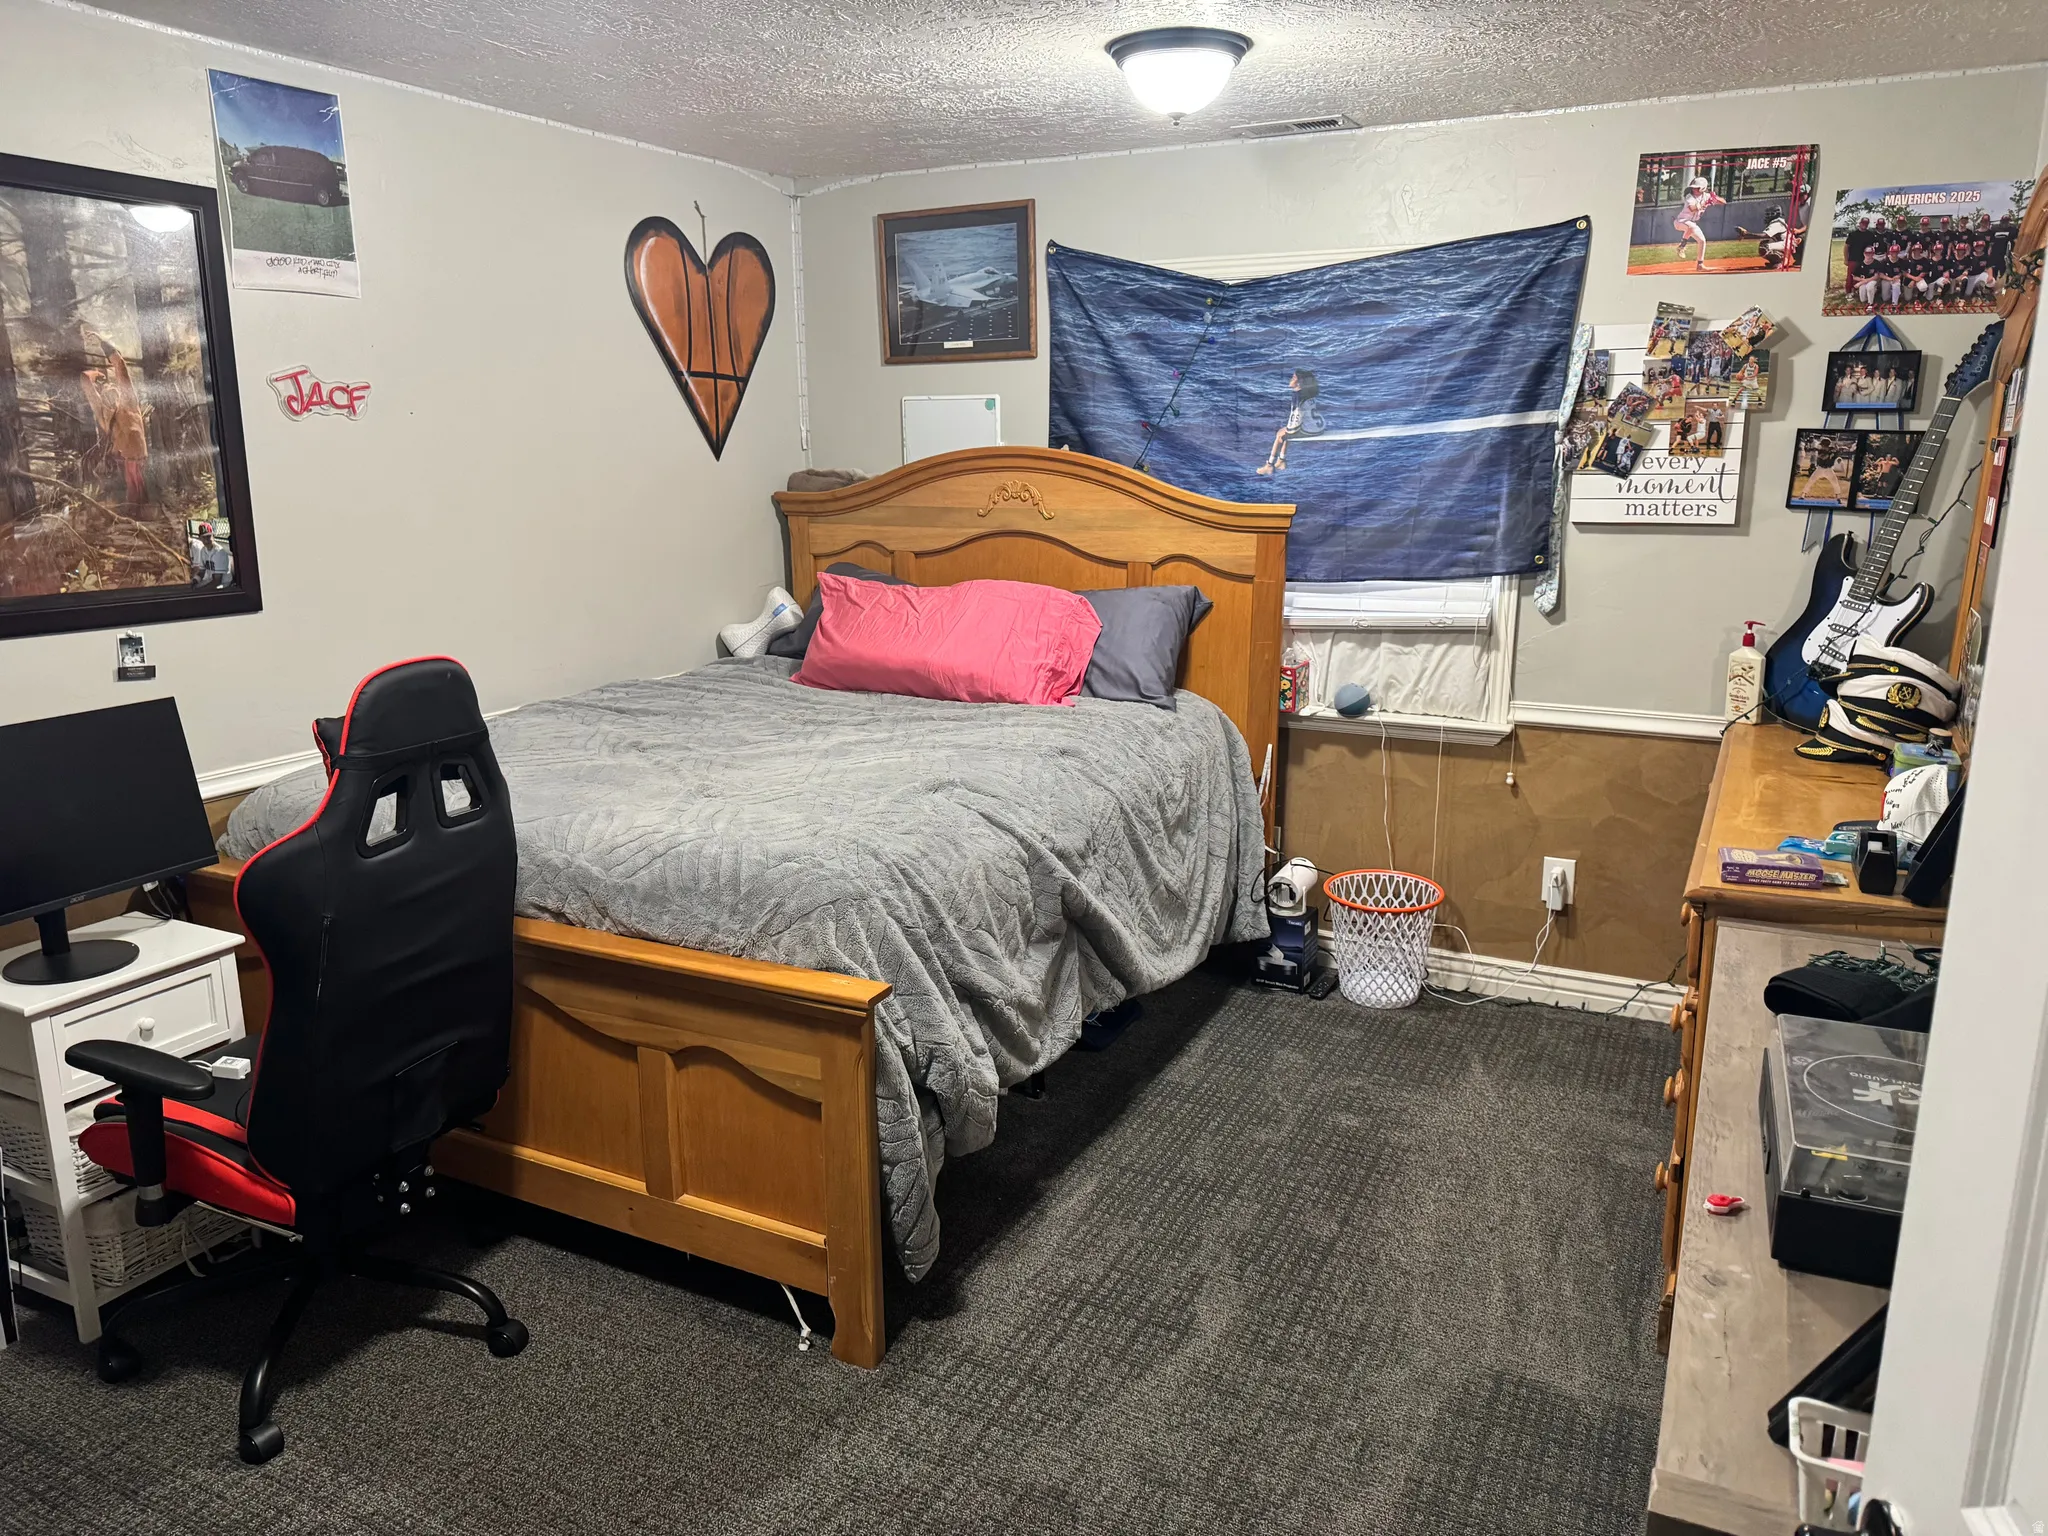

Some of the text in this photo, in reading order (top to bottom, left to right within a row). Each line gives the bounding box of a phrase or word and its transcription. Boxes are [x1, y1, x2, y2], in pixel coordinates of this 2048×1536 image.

[1746, 156, 1788, 170] JACE #5
[1884, 190, 1981, 206] MAVERICKS 2025
[1642, 455, 1707, 474] every
[1616, 462, 1736, 504] moment
[1624, 500, 1717, 517] matters
[1745, 869, 1780, 879] MOOSE
[1780, 871, 1817, 881] MASTER
[1849, 1071, 1888, 1082] AUDIO
